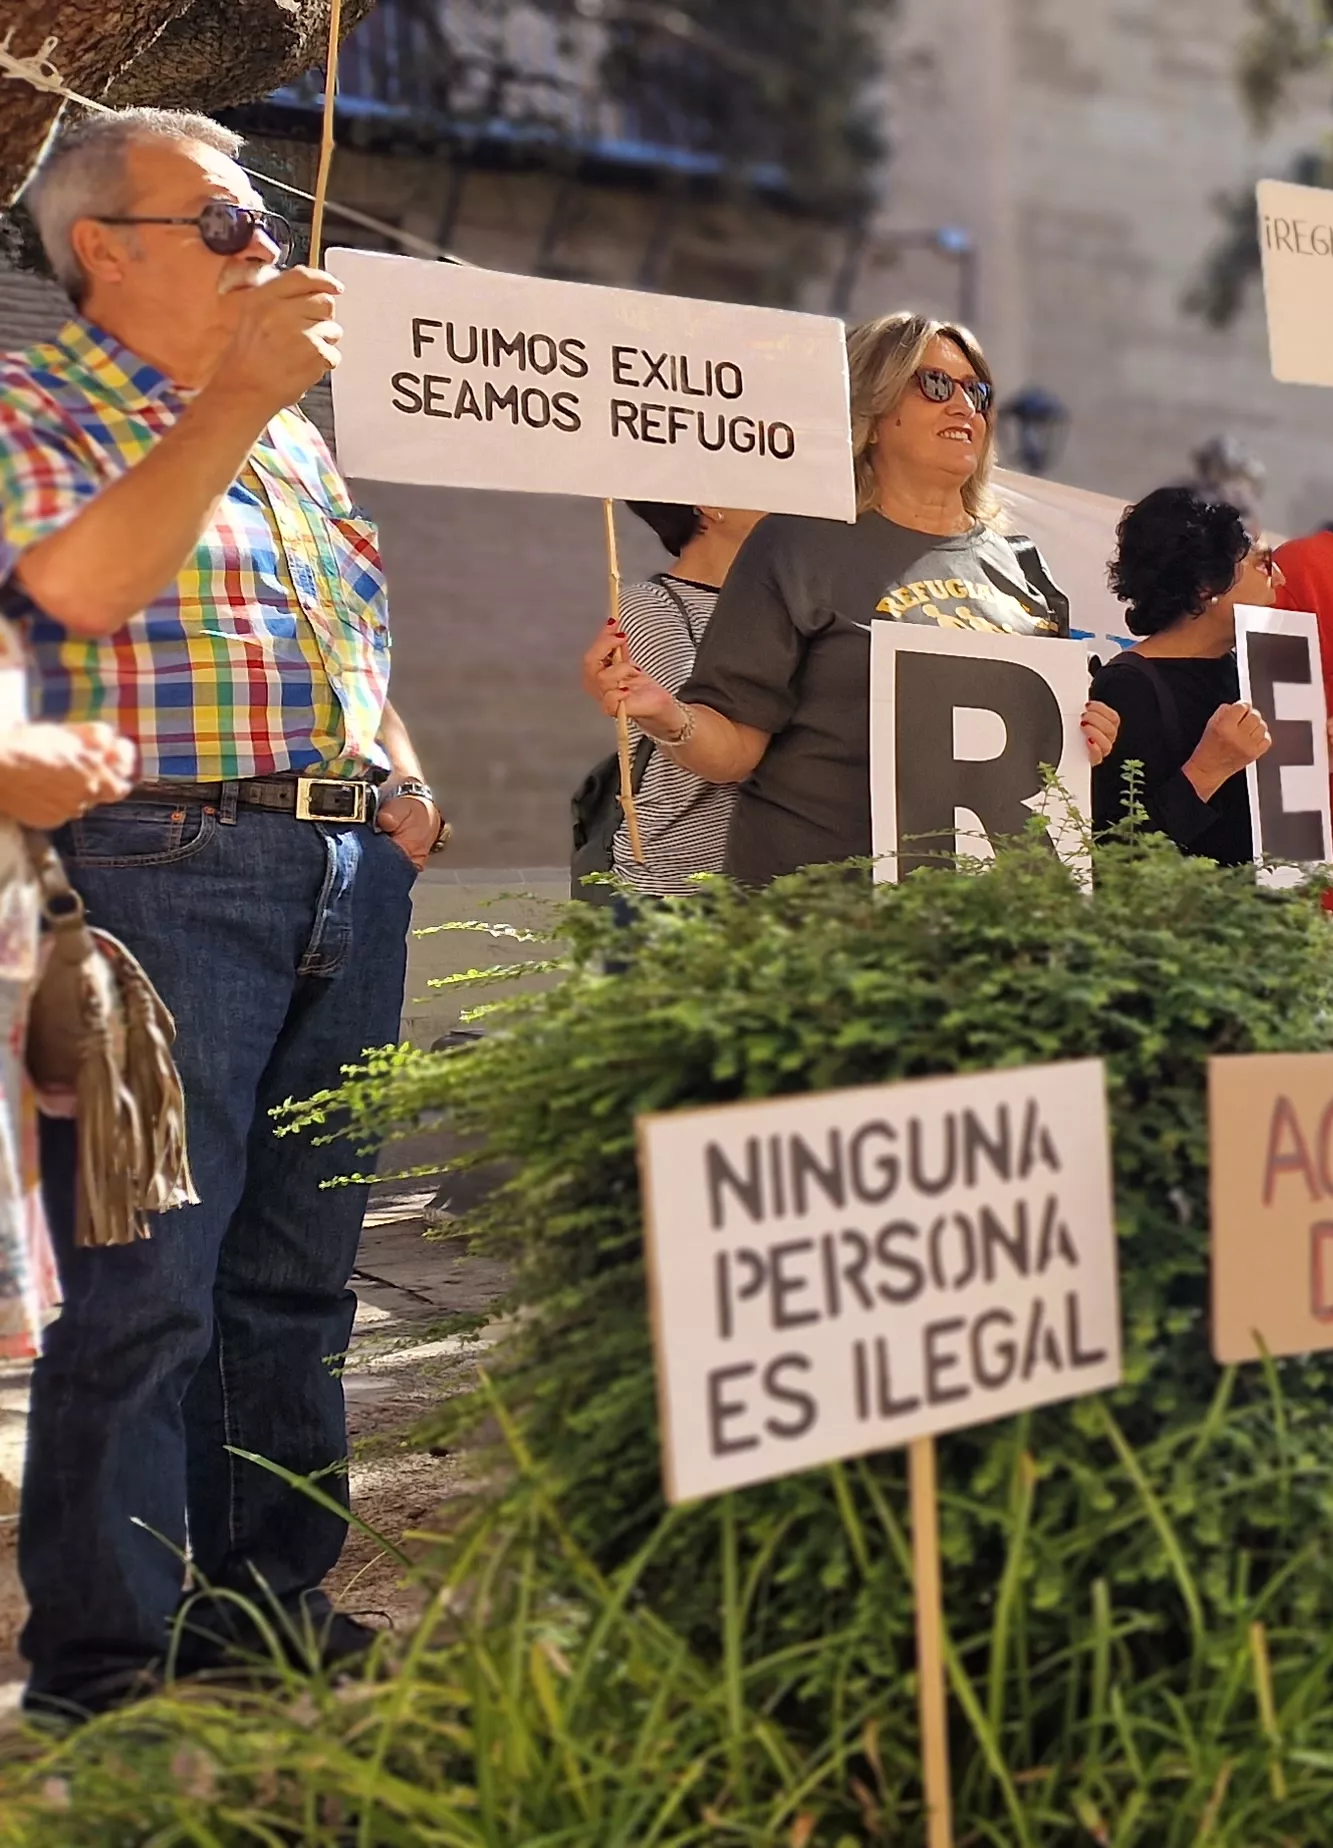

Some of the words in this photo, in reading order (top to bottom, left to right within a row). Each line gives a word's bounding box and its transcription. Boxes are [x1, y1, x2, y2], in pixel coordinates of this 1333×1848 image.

[391, 372, 582, 433] SEAMOS
[610, 398, 796, 460] REFUGIO
[411, 318, 589, 378] FUIMOS
[611, 345, 744, 400] EXILIO
[895, 649, 1065, 885] R
[1246, 631, 1326, 862] E
[704, 1096, 1062, 1231] NINGUNA
[714, 1192, 1081, 1341] PERSONA
[706, 1351, 819, 1458] ES
[852, 1289, 1108, 1423] ILEGAL
